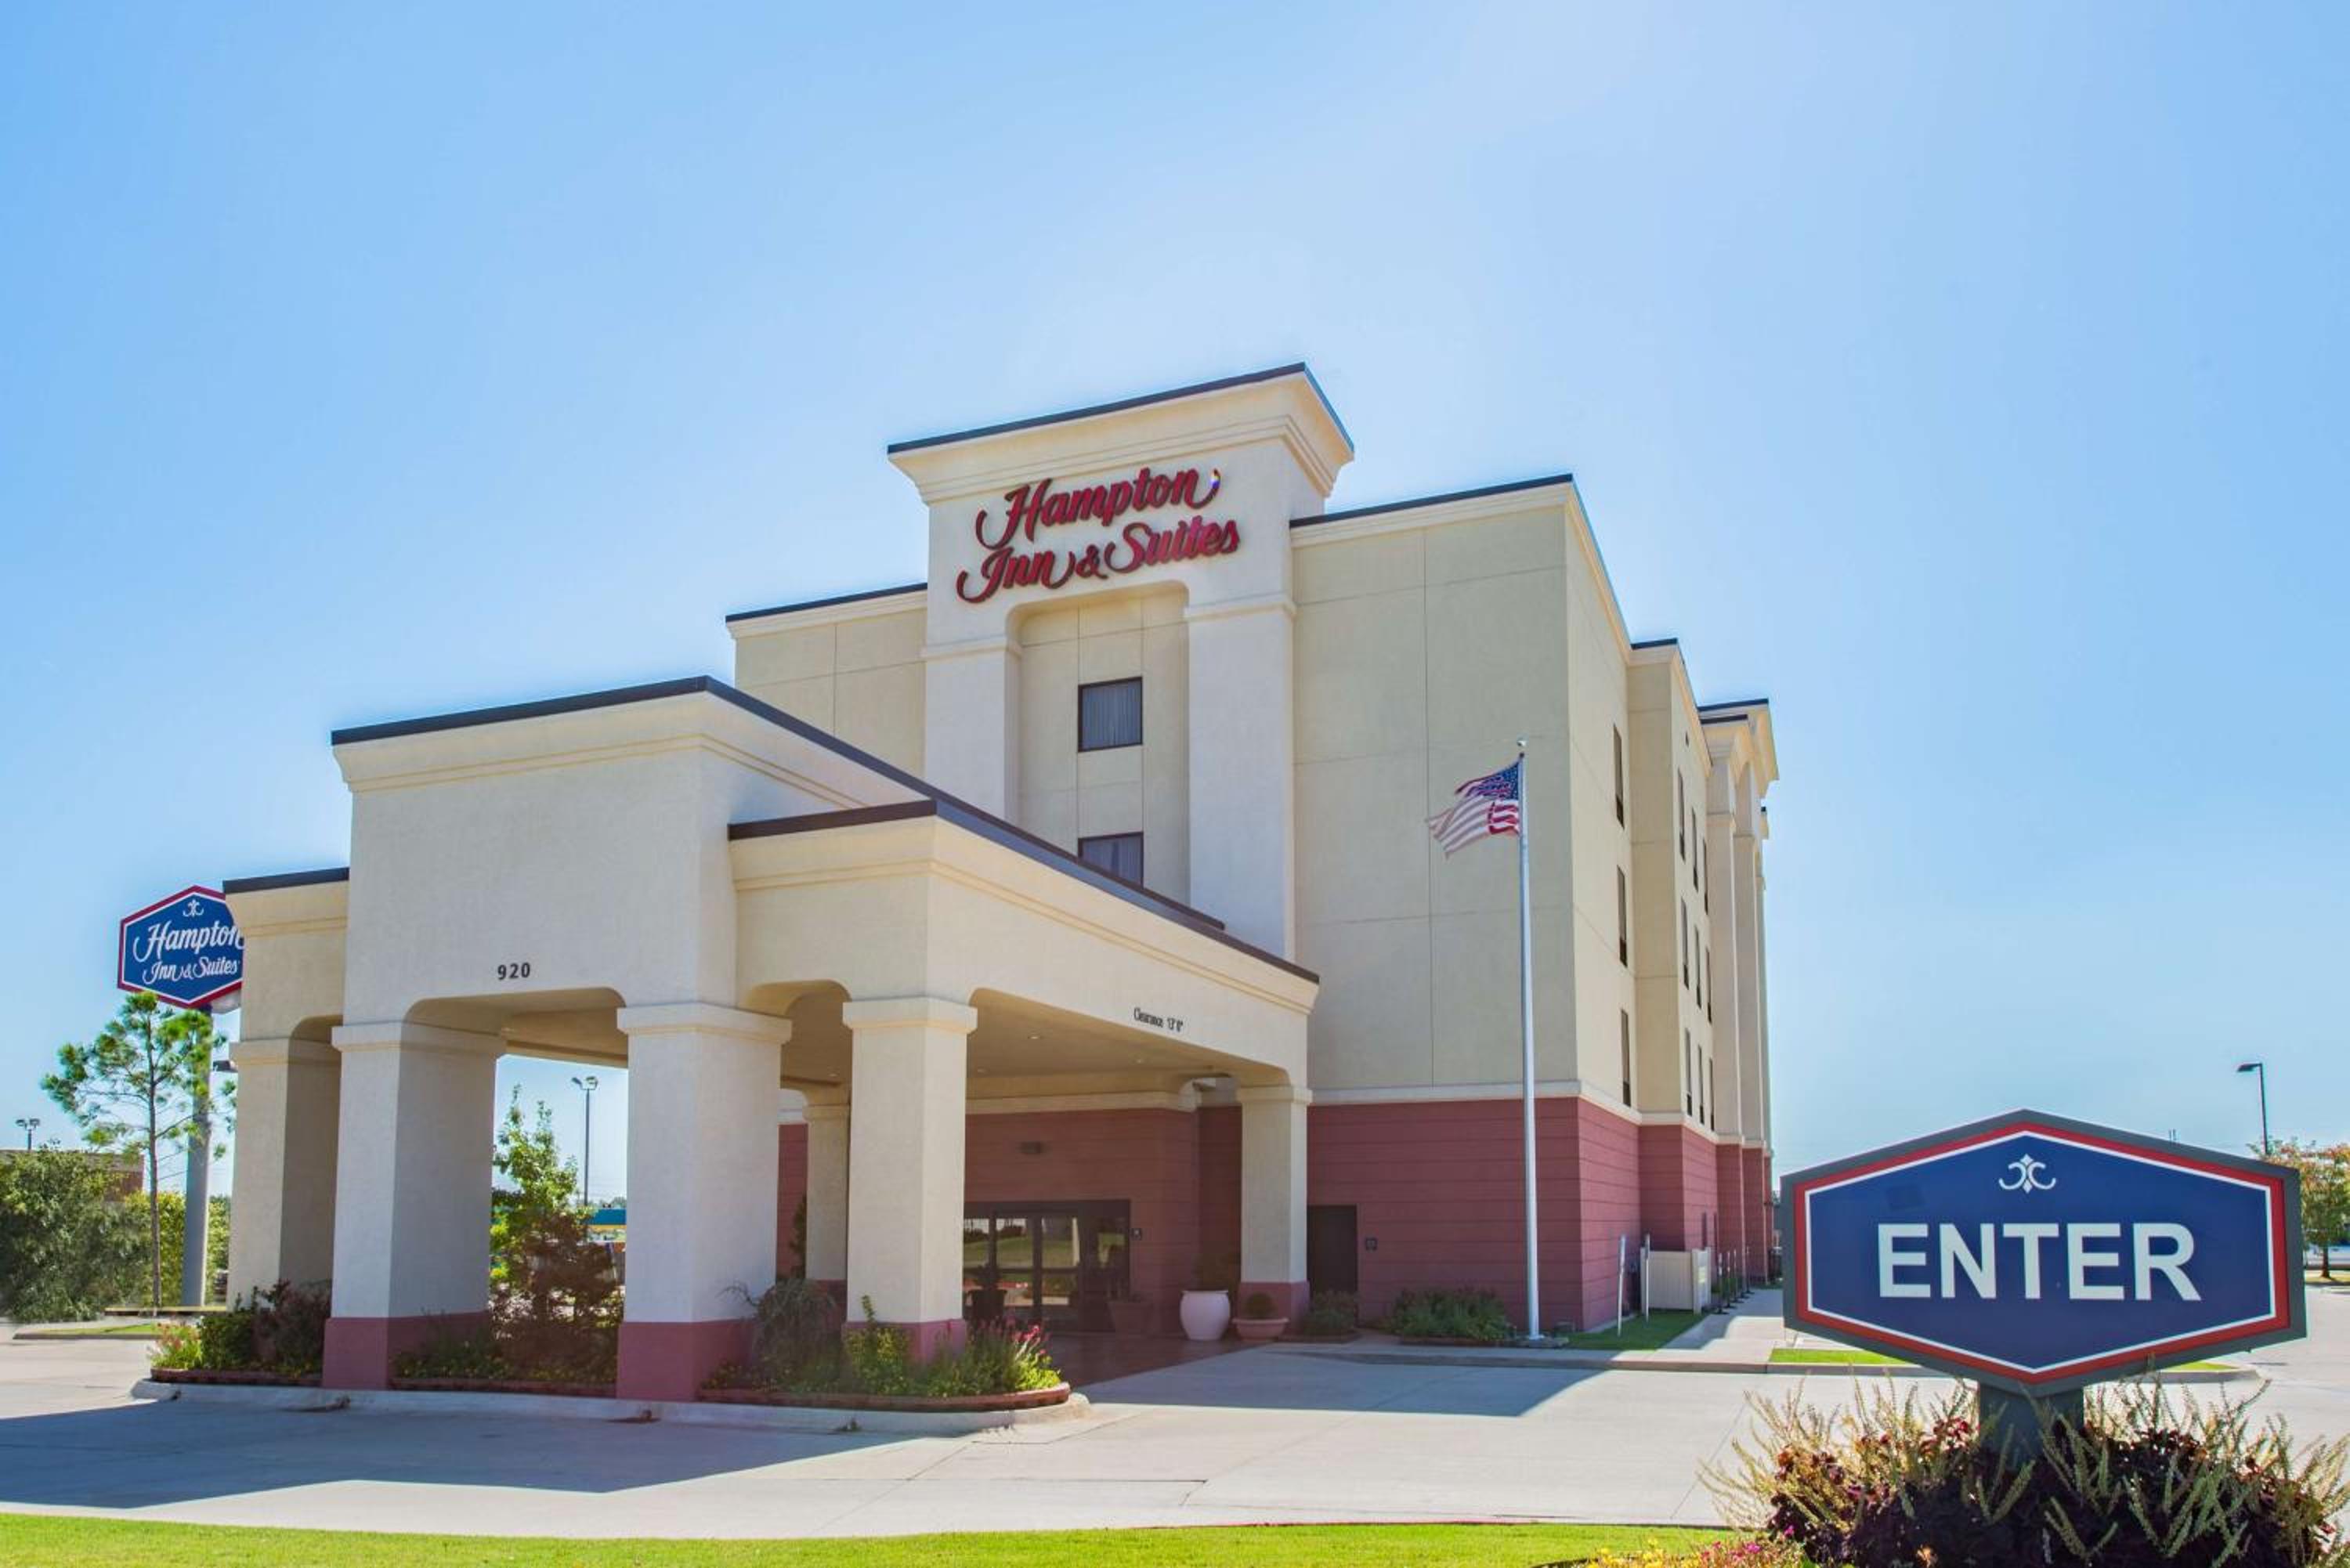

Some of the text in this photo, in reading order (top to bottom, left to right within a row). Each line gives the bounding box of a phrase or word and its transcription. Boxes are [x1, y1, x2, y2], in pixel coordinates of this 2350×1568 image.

[975, 468, 1221, 549] Hampton
[956, 515, 1241, 603] Inn & Suites
[132, 919, 245, 963] Hampton
[142, 961, 182, 985] Inn
[192, 956, 238, 978] Suites
[497, 962, 531, 981] 920
[1878, 1222, 2202, 1301] ENTER
